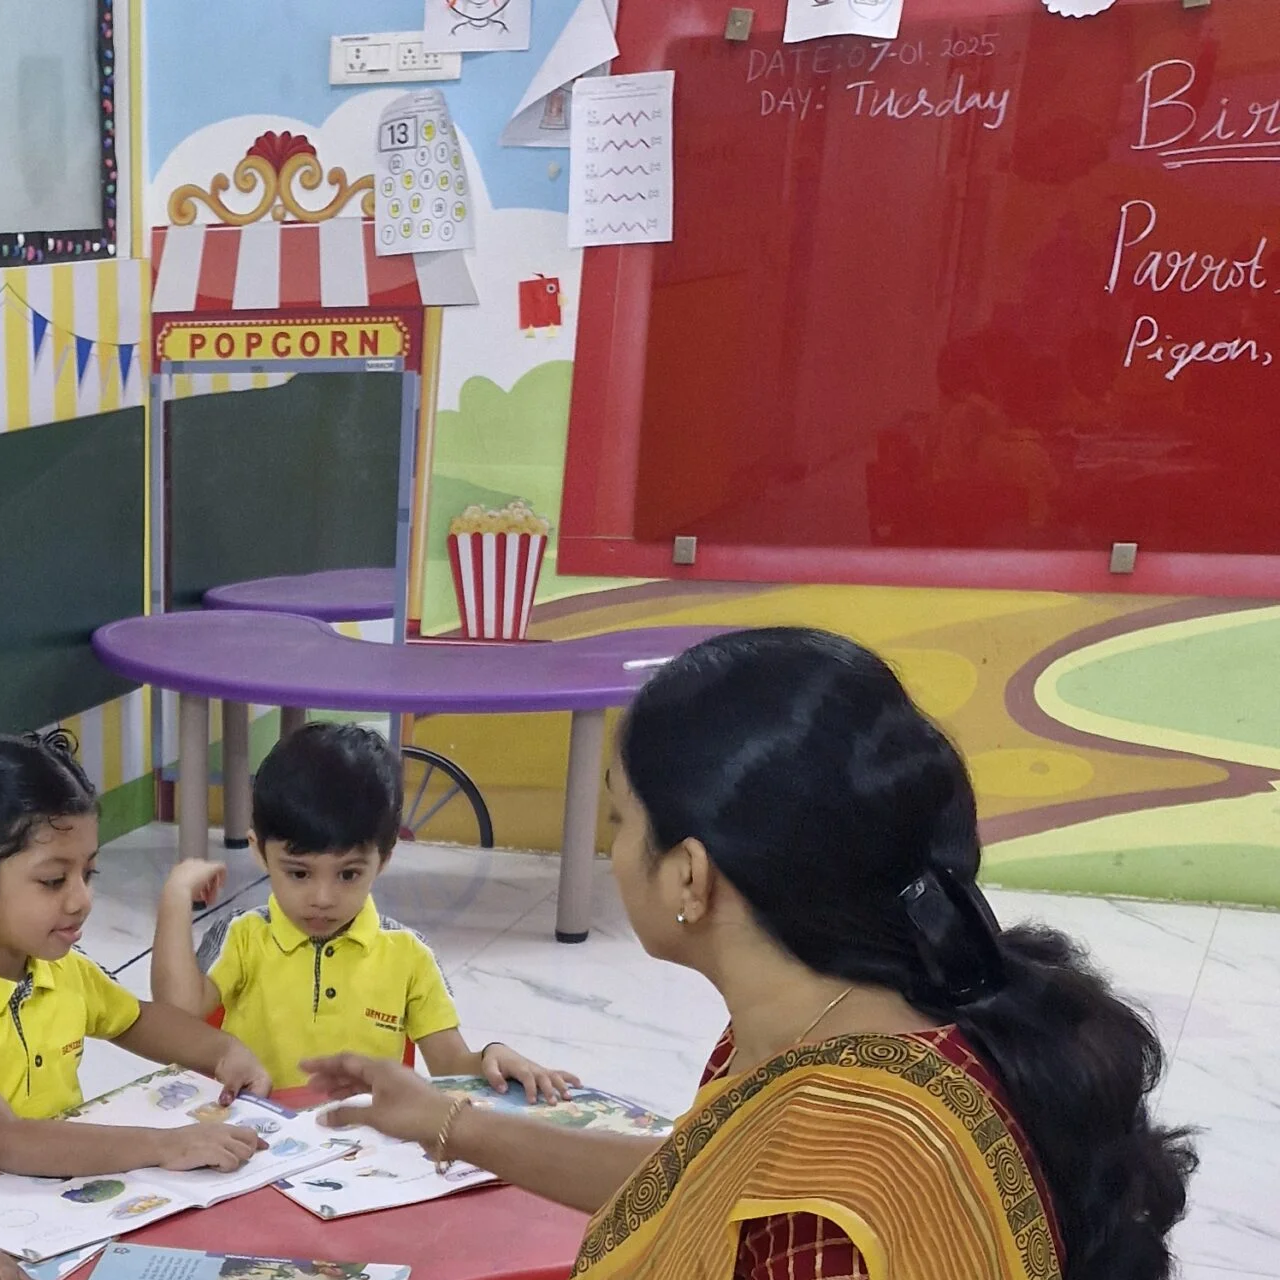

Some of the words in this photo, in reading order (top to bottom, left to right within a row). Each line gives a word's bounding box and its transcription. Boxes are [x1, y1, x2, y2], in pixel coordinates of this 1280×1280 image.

[760, 86, 824, 120] DAY:
[847, 75, 1010, 129] Tuesday
[387, 123, 409, 145] 13
[189, 330, 379, 358] POPCORN
